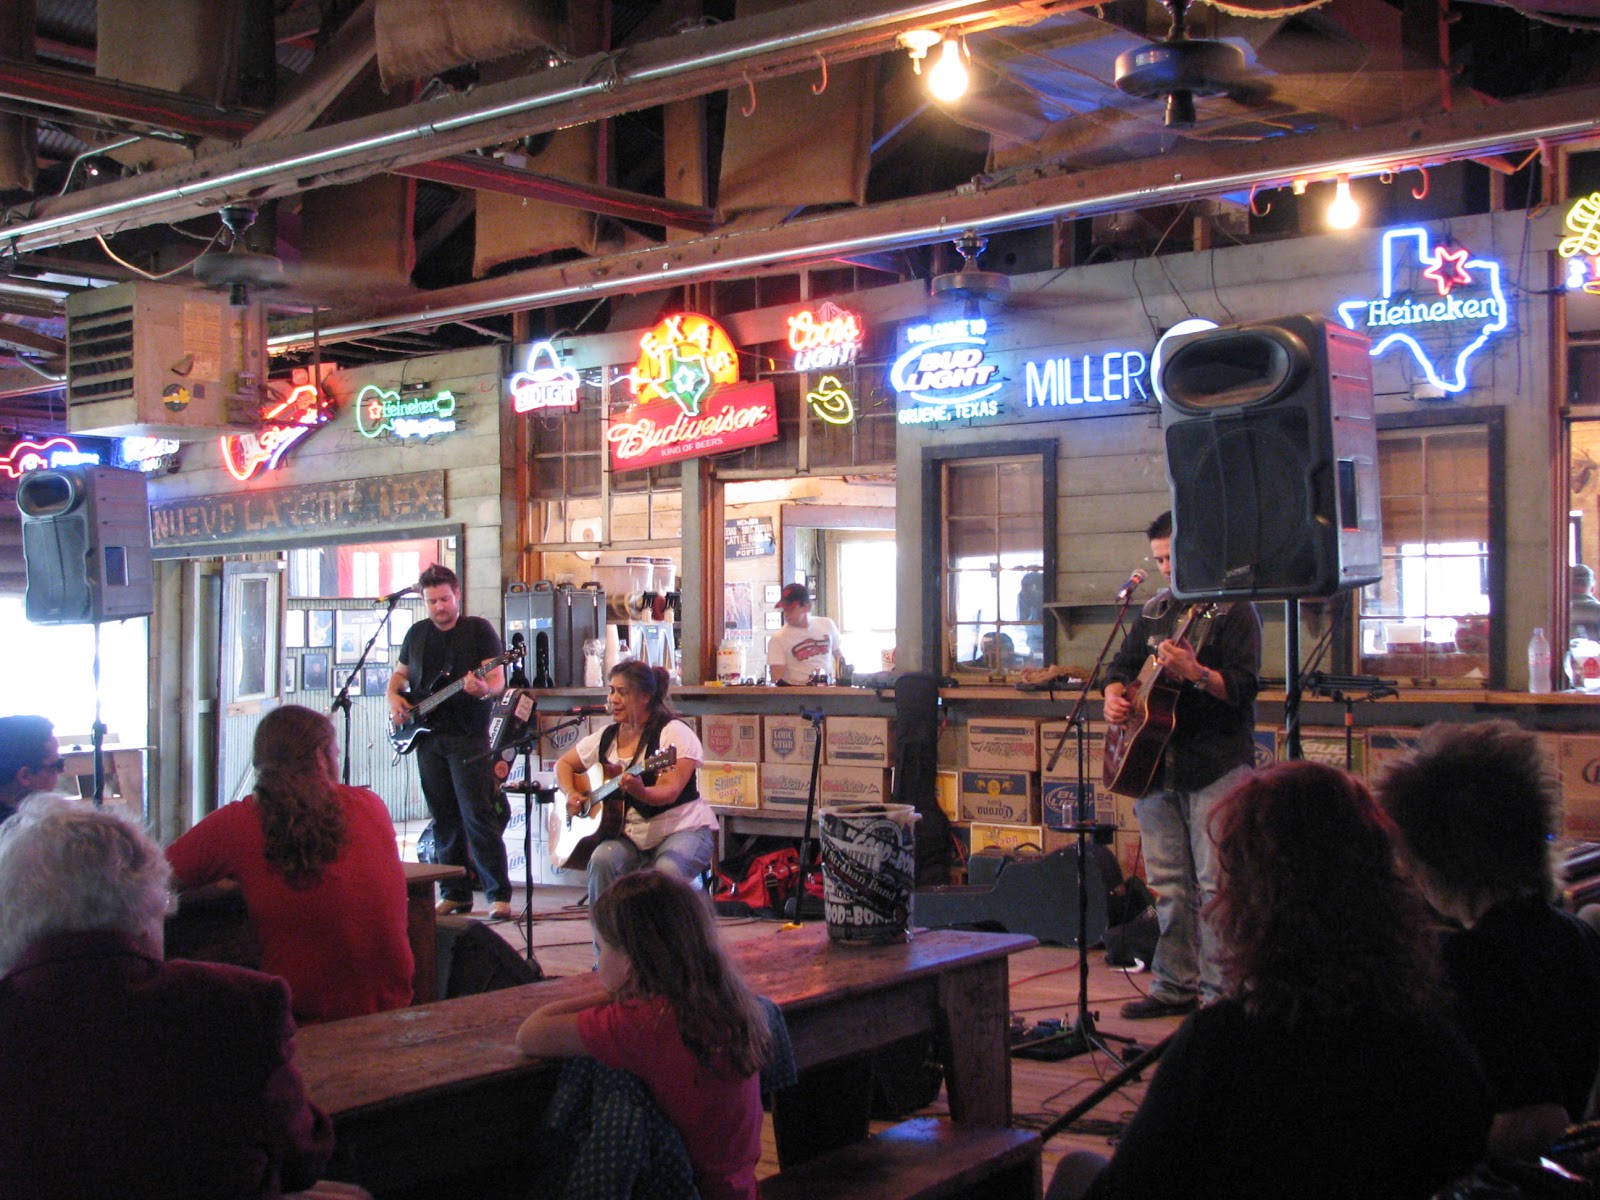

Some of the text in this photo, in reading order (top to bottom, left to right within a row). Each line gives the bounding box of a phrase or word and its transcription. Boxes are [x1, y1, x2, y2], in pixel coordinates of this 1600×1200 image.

[1367, 295, 1498, 326] Heineken
[788, 311, 859, 351] Coors
[630, 315, 731, 394] TEXAS
[918, 348, 984, 372] BUD
[904, 366, 996, 392] LIGHT
[1026, 351, 1148, 407] MILLER
[382, 398, 439, 417] Heineken
[955, 400, 998, 419] TEXAS
[607, 405, 771, 459] Budweiser
[661, 438, 723, 457] KING OF BEERS
[773, 740, 794, 749] STAR
[774, 729, 793, 739] LONE
[715, 774, 743, 791] Shiner
[1098, 793, 1112, 801] 24
[977, 806, 1014, 819] Corona
[868, 878, 897, 901] Band
